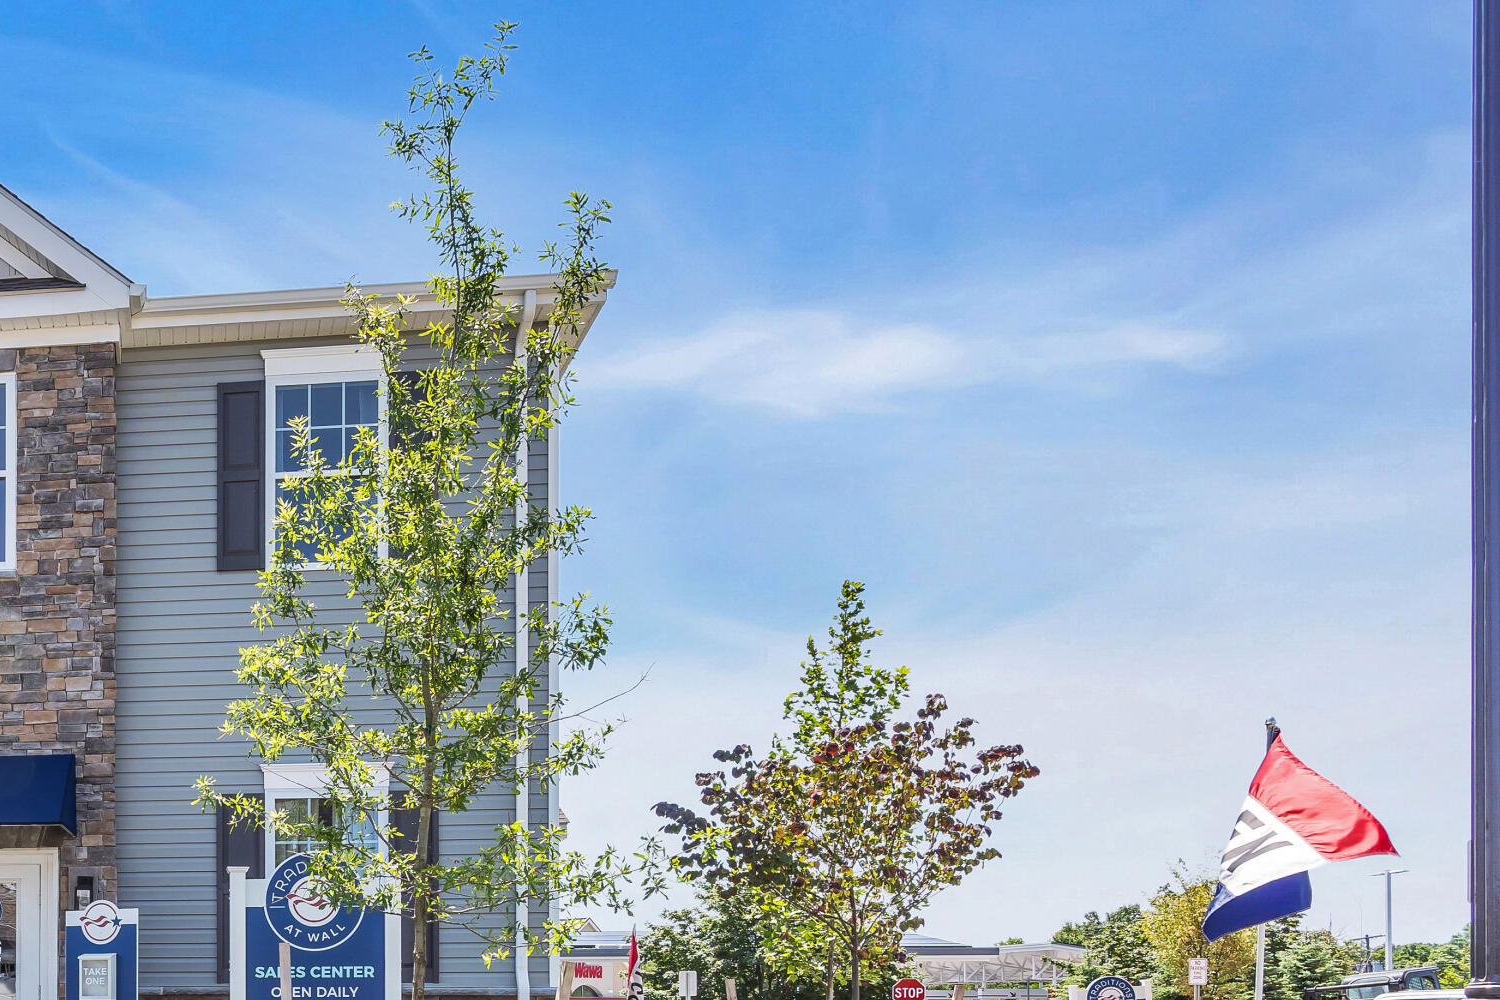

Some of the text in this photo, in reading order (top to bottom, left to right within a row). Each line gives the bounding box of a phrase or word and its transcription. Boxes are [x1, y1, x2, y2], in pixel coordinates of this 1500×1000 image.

[284, 923, 346, 942] AT WALL
[83, 967, 108, 976] TAKE
[309, 965, 375, 979] CENTER
[574, 962, 603, 978] Wawa
[85, 977, 105, 985] ONE
[271, 986, 359, 998] OEN DAILY
[894, 987, 924, 999] STOP
[1089, 979, 1134, 1000] TRADITIONS
